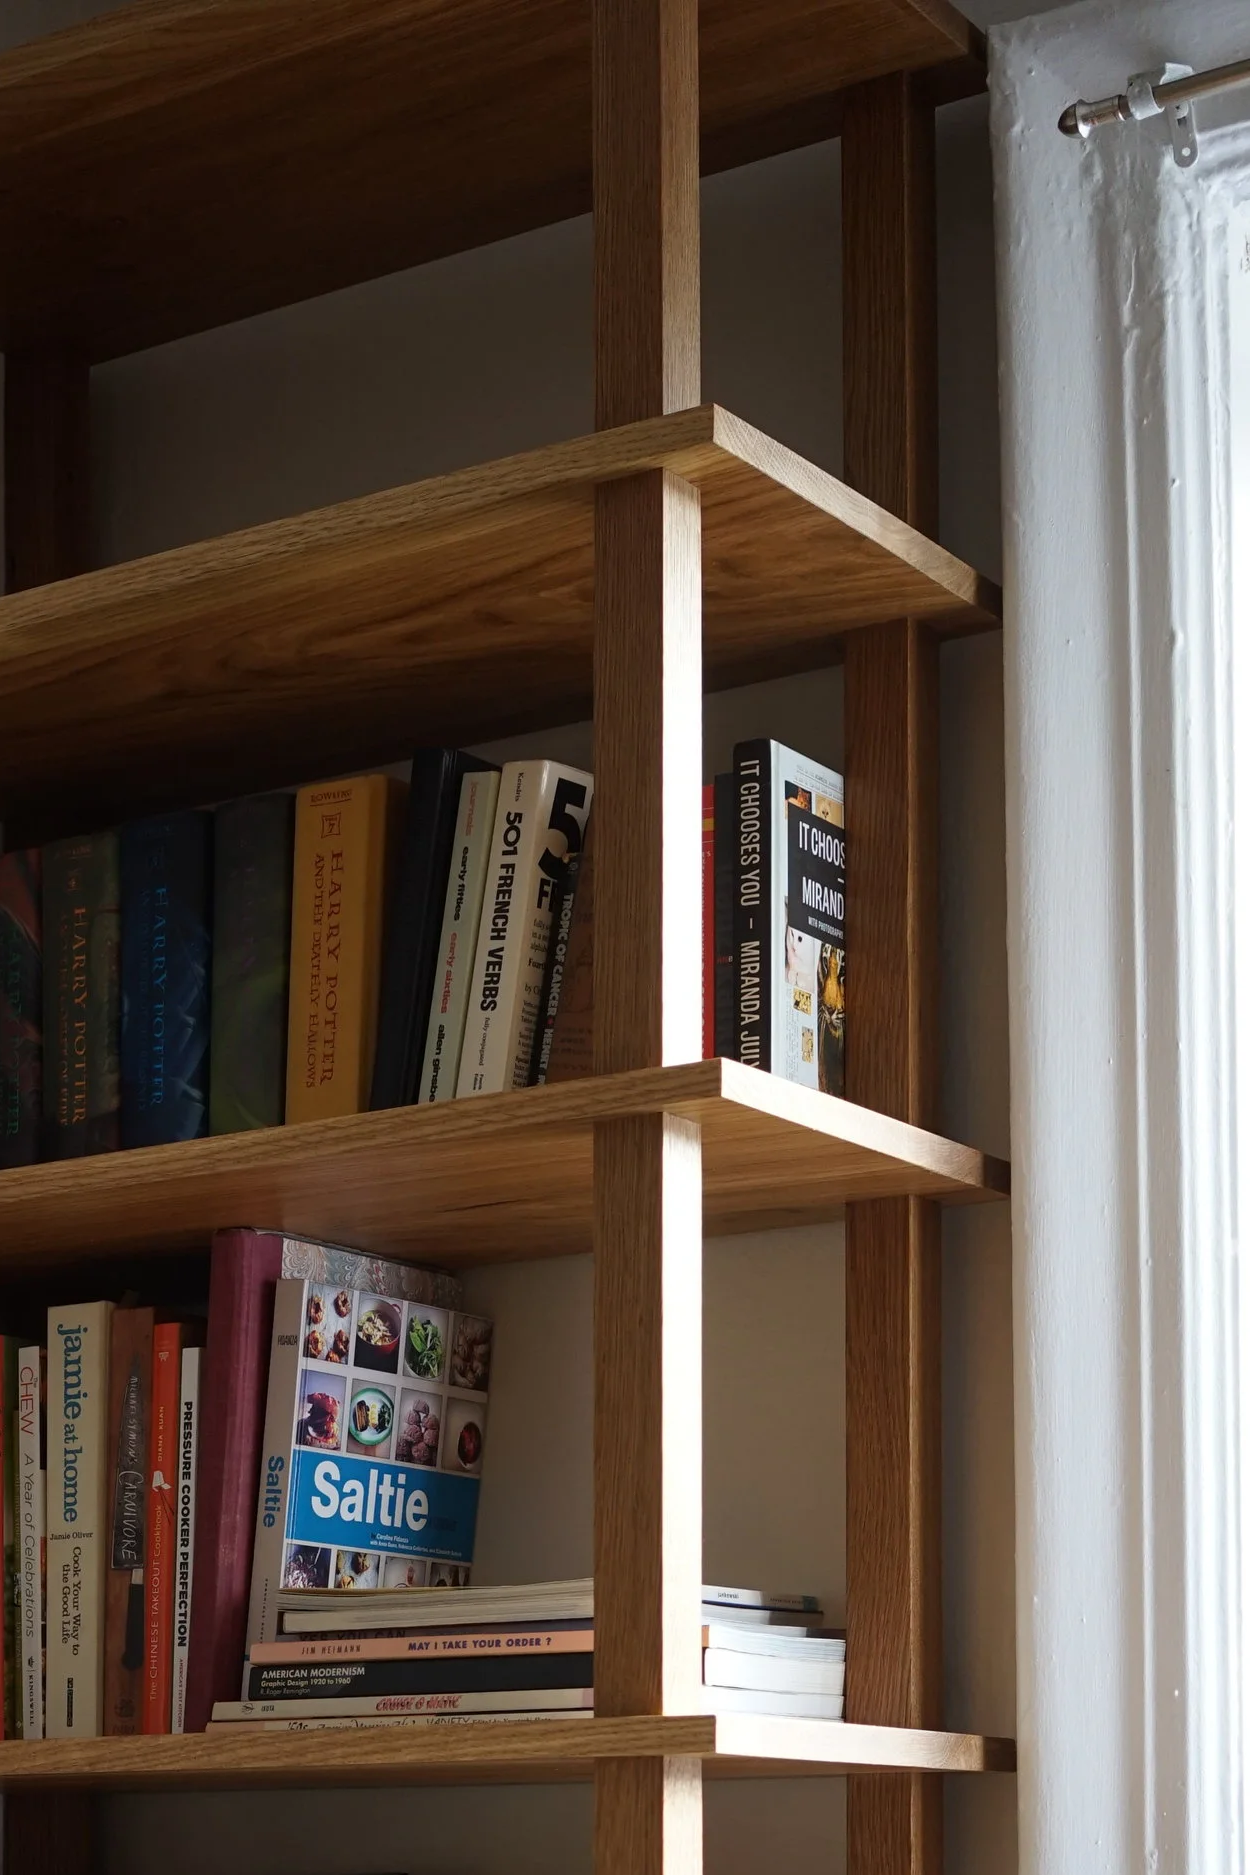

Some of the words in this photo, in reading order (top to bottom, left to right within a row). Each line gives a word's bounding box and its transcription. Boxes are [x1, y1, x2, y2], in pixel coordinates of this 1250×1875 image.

[739, 759, 760, 777] IT
[501, 810, 523, 857] 501
[739, 781, 761, 867] CHOOSES
[799, 820, 810, 851] IT
[325, 849, 345, 963] HARRY
[490, 862, 516, 941] FRENCH
[739, 869, 761, 907] YOU
[151, 884, 168, 994] HARRY
[557, 892, 574, 942] TROPIC
[71, 904, 88, 1009] HARRY
[480, 945, 505, 1013] VERBS
[739, 940, 761, 1026] MIRANDA
[547, 964, 564, 1017] CANCER
[150, 1002, 166, 1107] POTTER
[304, 1013, 321, 1090] HALLOWS
[319, 974, 341, 1088] POTTER
[435, 1023, 446, 1056] allen
[71, 1019, 88, 1126] POTTER
[56, 1323, 89, 1420] jamie
[19, 1365, 35, 1436] CHEW
[62, 1422, 77, 1446] at
[180, 1401, 193, 1481] PRESSURE
[24, 1474, 35, 1508] Year
[62, 1447, 83, 1523] home
[262, 1454, 285, 1528] Saltie
[310, 1459, 430, 1532] Saltie
[24, 1512, 36, 1532] of
[50, 1532, 71, 1542] Jamie
[117, 1469, 145, 1561] CARNIVORE
[154, 1504, 163, 1557] Cookbook
[179, 1483, 191, 1549] COOKER
[24, 1534, 36, 1638] Celebrations
[72, 1546, 82, 1579] Cook
[151, 1559, 162, 1616] TAKEOUT
[61, 1586, 71, 1619] Good
[71, 1580, 82, 1612] Your
[176, 1551, 189, 1647] PERFECTION
[61, 1620, 71, 1645] Life
[70, 1613, 82, 1642] Way
[150, 1621, 160, 1679] CHINESE
[301, 1646, 316, 1655] JIM
[321, 1644, 361, 1655] HEIMANN
[407, 1641, 431, 1651] MAY
[442, 1640, 468, 1649] TAKE
[472, 1638, 502, 1648] YOUR
[506, 1637, 541, 1647] ORDER
[260, 1680, 286, 1689] Graphic
[286, 1678, 309, 1687] Design
[261, 1668, 308, 1680] AMERICAN
[309, 1666, 366, 1678] MODERNISM
